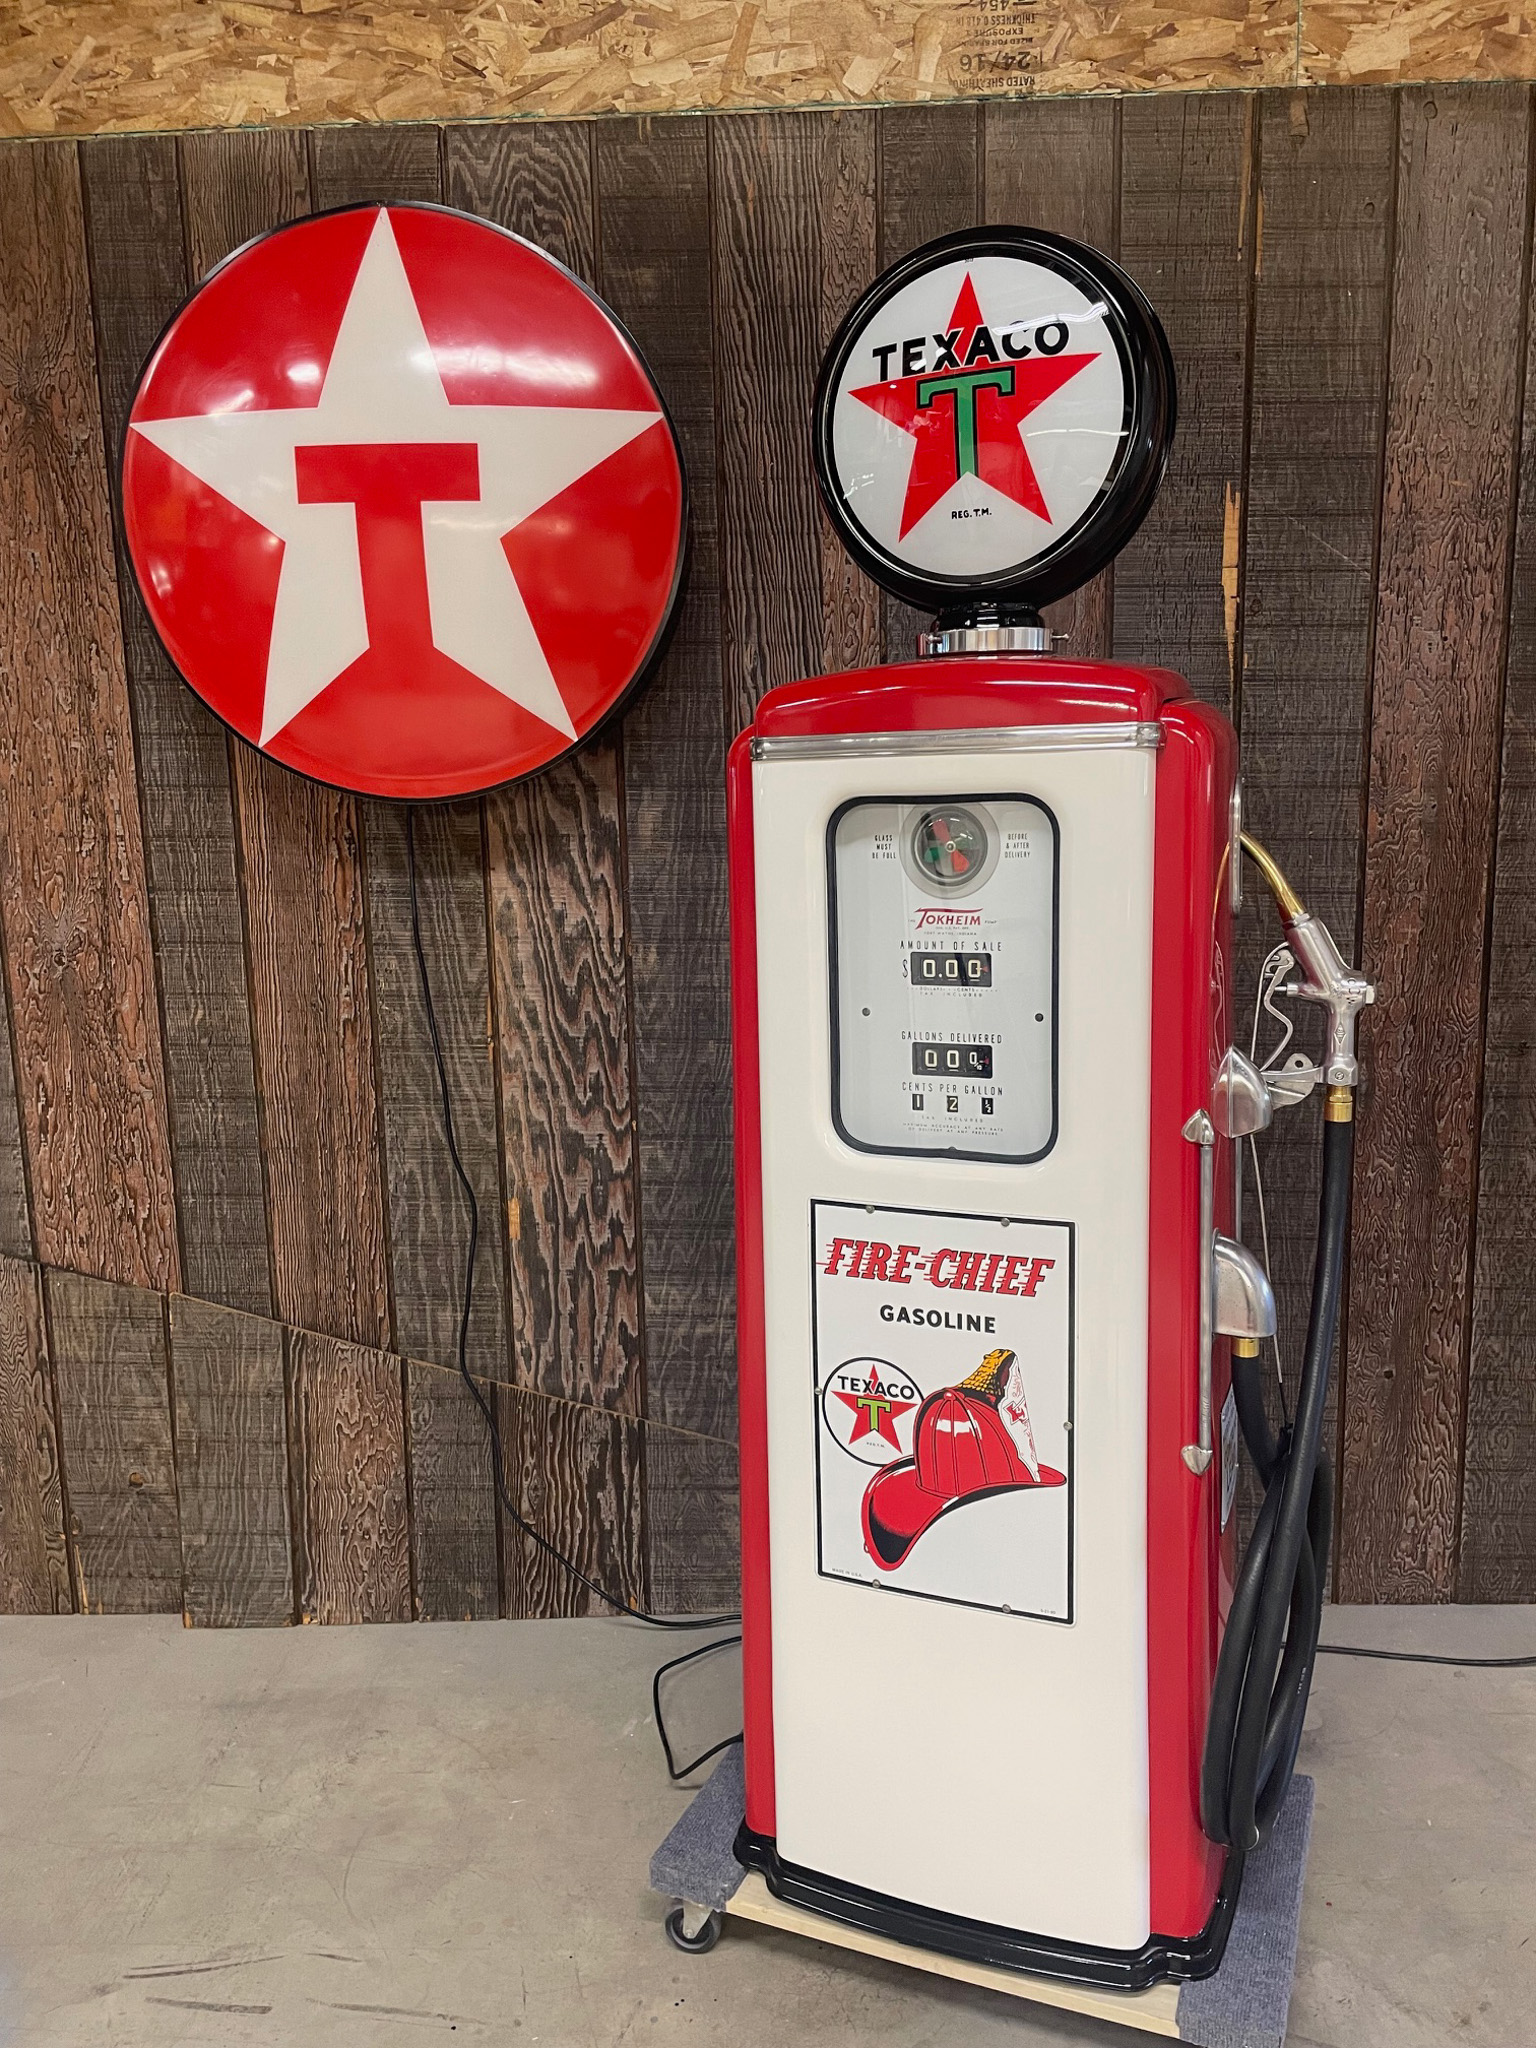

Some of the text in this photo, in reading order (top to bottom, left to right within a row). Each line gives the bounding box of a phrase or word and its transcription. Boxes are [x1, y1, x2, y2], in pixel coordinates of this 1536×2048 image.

[960, 51, 1031, 73] 24/16
[1007, 76, 1036, 87] RATED
[873, 320, 1070, 383] TEXACO
[874, 834, 893, 842] GLASS
[1007, 833, 1028, 841] BEFORE
[1004, 851, 1031, 859] DELIVERY
[914, 908, 983, 930] TOKHEIM
[899, 940, 1002, 952] AMOUNT OF SALE
[901, 1030, 1003, 1044] GALLONS DELIVERED
[902, 1081, 1003, 1096] CENTS PER GALLON
[949, 1097, 958, 1111] 2
[824, 1237, 1056, 1298] FIRE-CHIEF
[880, 1304, 996, 1334] GASOLINE
[837, 1375, 915, 1400] TEXACO
